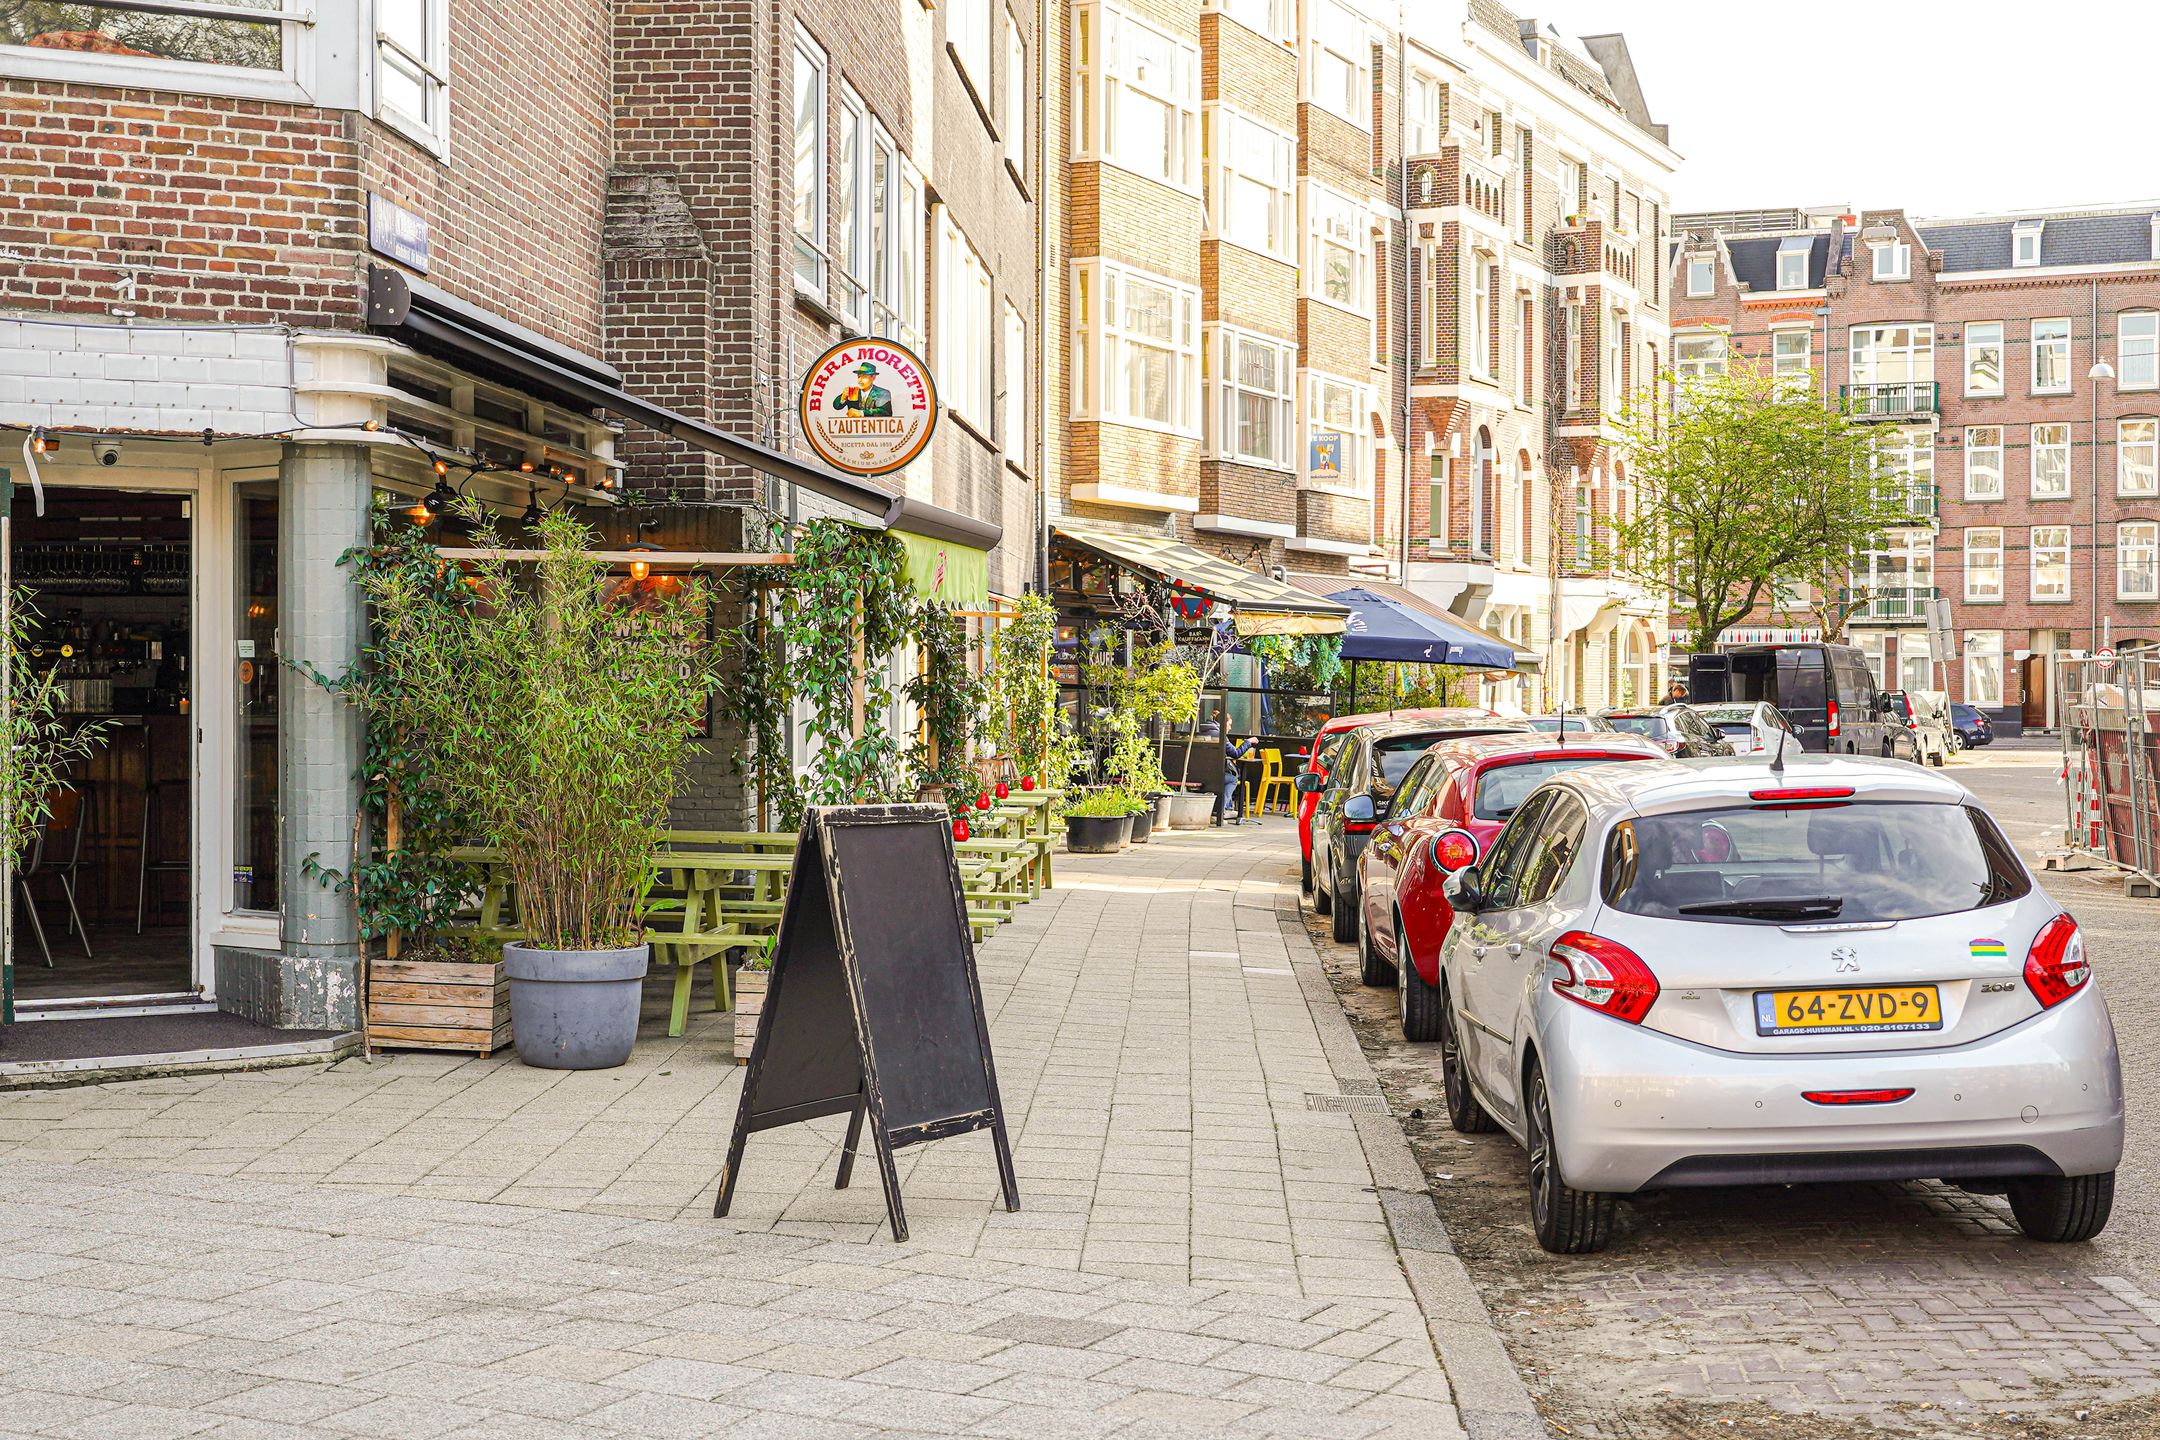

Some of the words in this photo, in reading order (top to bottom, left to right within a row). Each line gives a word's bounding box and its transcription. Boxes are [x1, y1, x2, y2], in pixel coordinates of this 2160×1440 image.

[809, 352, 855, 411] BIRRA
[857, 347, 927, 411] MORETTI
[828, 419, 905, 434] L'AUTENTICA
[1981, 982, 2016, 993] 208
[1787, 991, 1929, 1022] 64-ZVD-9
[1761, 1014, 1774, 1023] NL
[1773, 1025, 1855, 1035] GARAGE-HUISMAN.NL
[1860, 1023, 1930, 1032] 020-6167133
